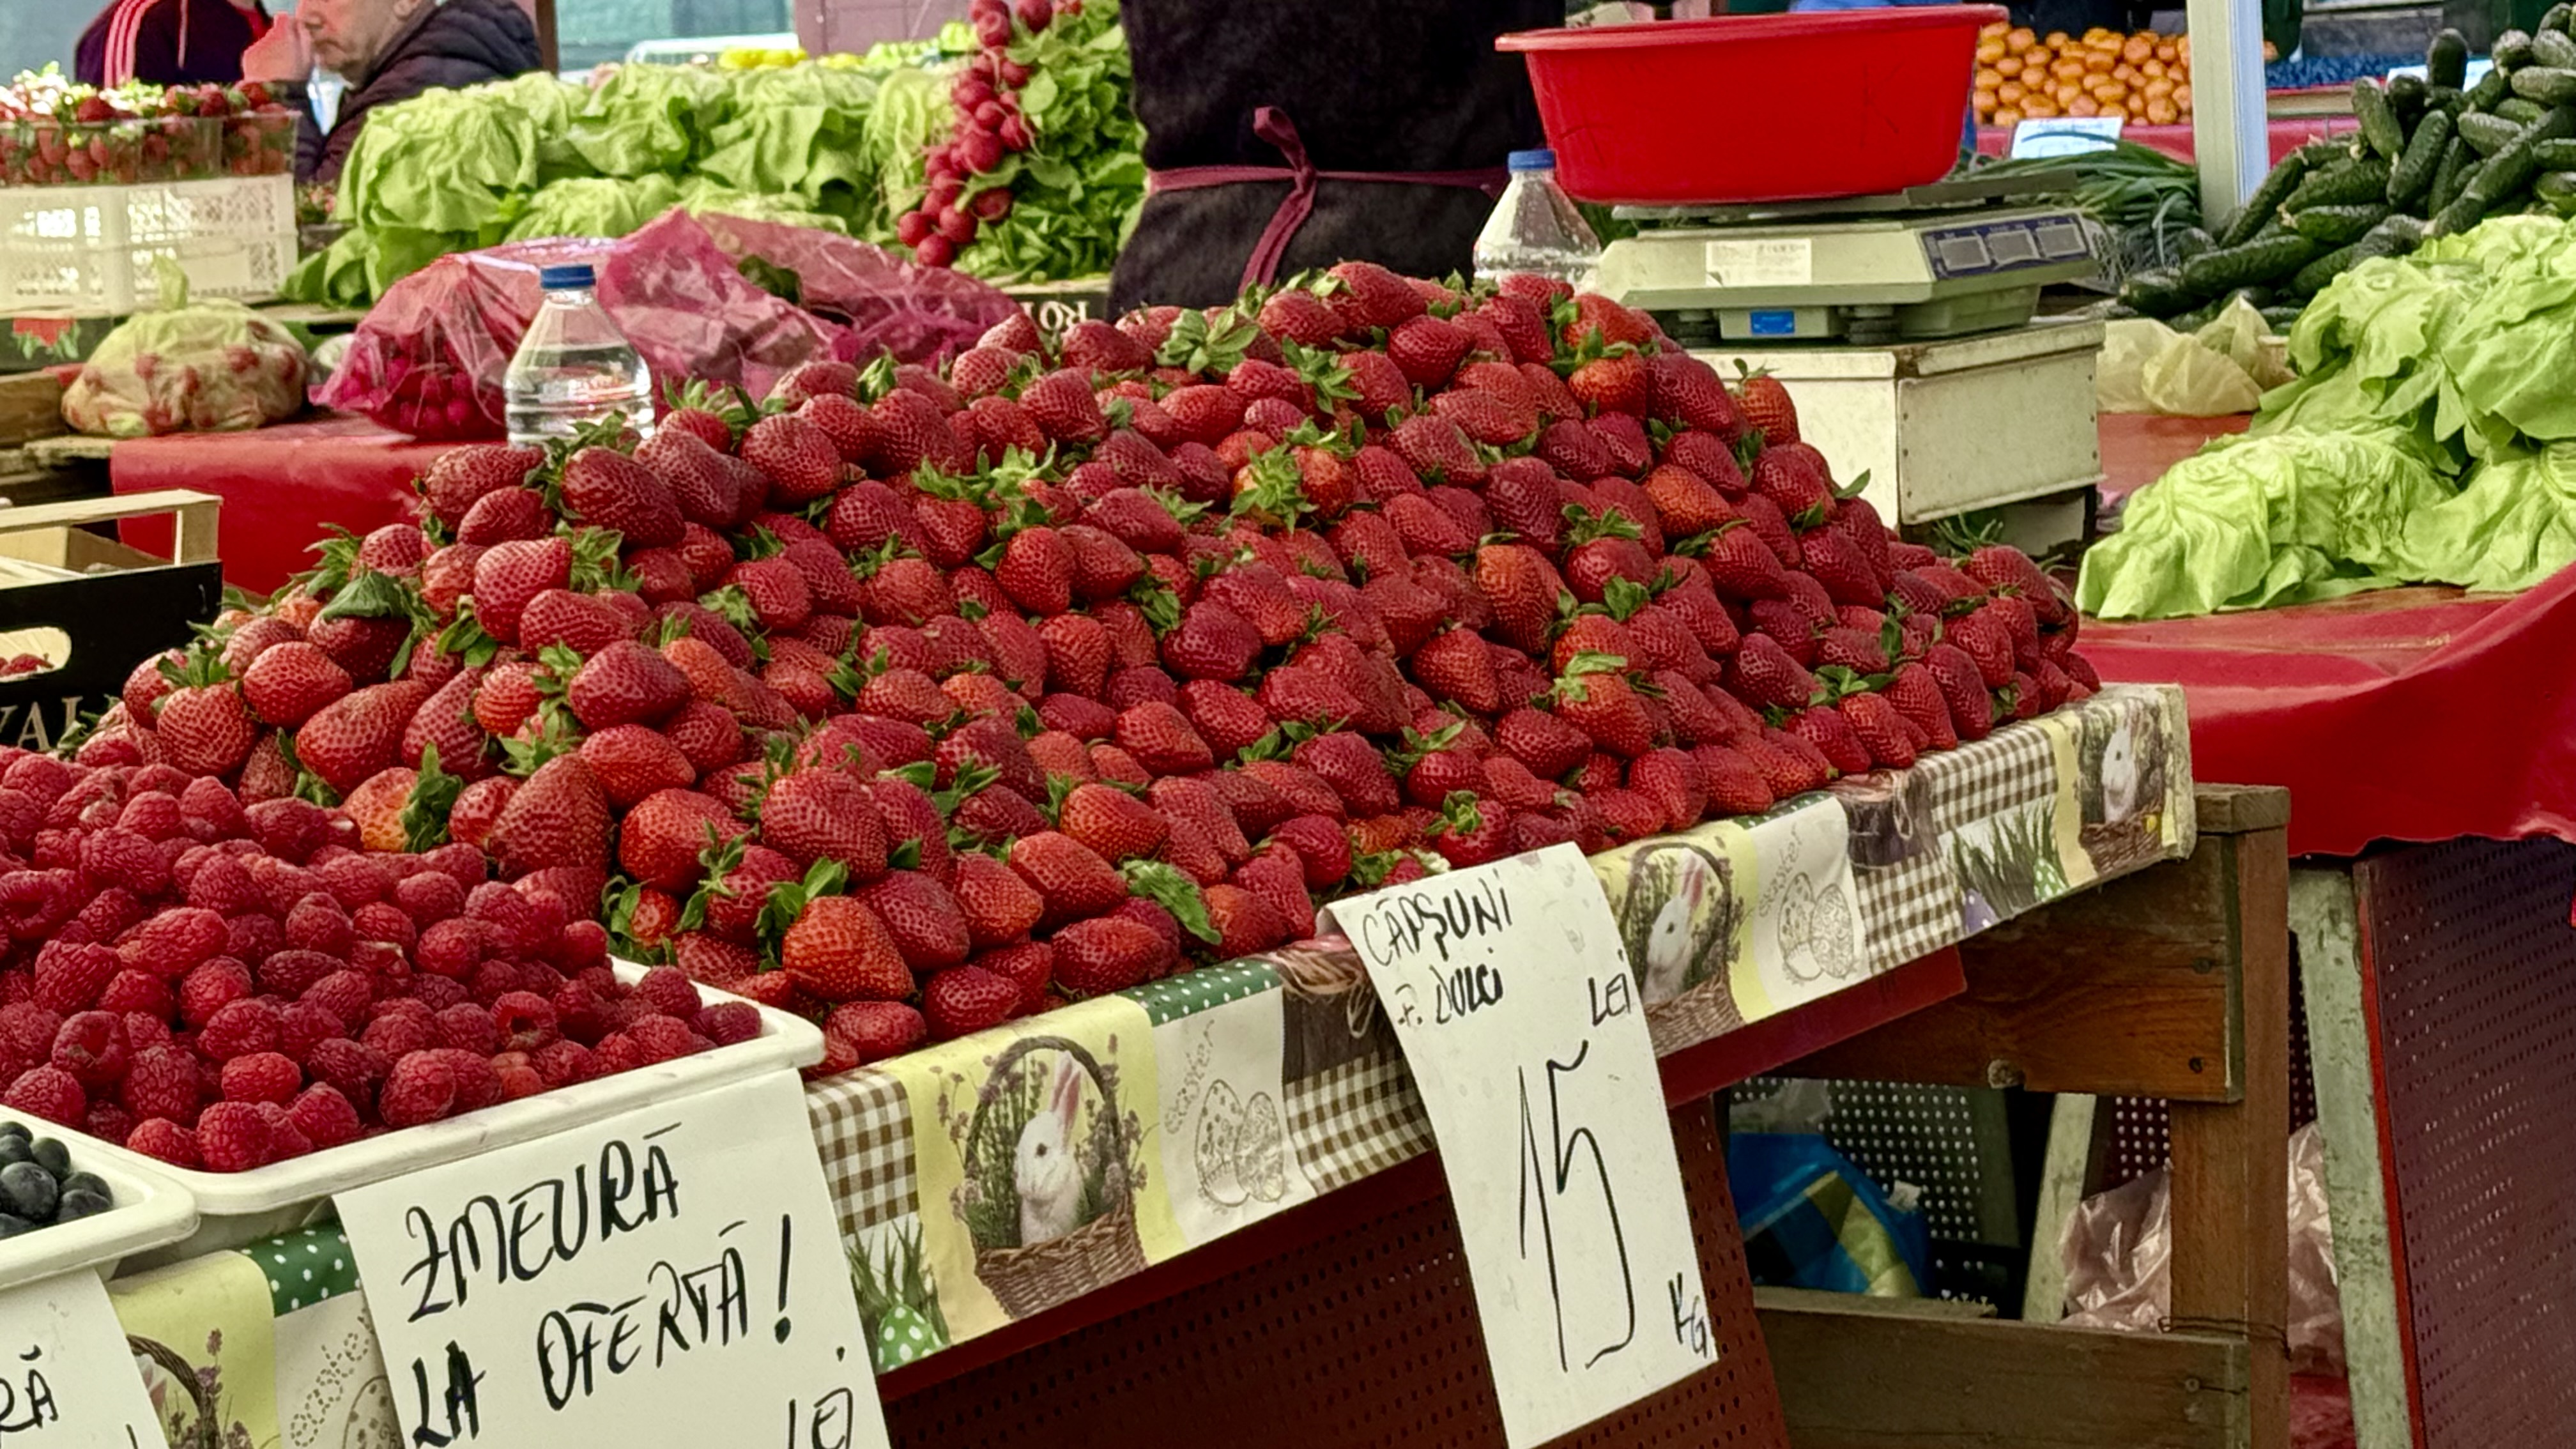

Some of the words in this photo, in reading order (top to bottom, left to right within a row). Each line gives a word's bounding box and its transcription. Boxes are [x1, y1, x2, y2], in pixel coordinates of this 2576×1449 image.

[1164, 1018, 1215, 1135] easter
[1518, 1039, 1636, 1373] 15
[411, 1340, 487, 1448] LA
